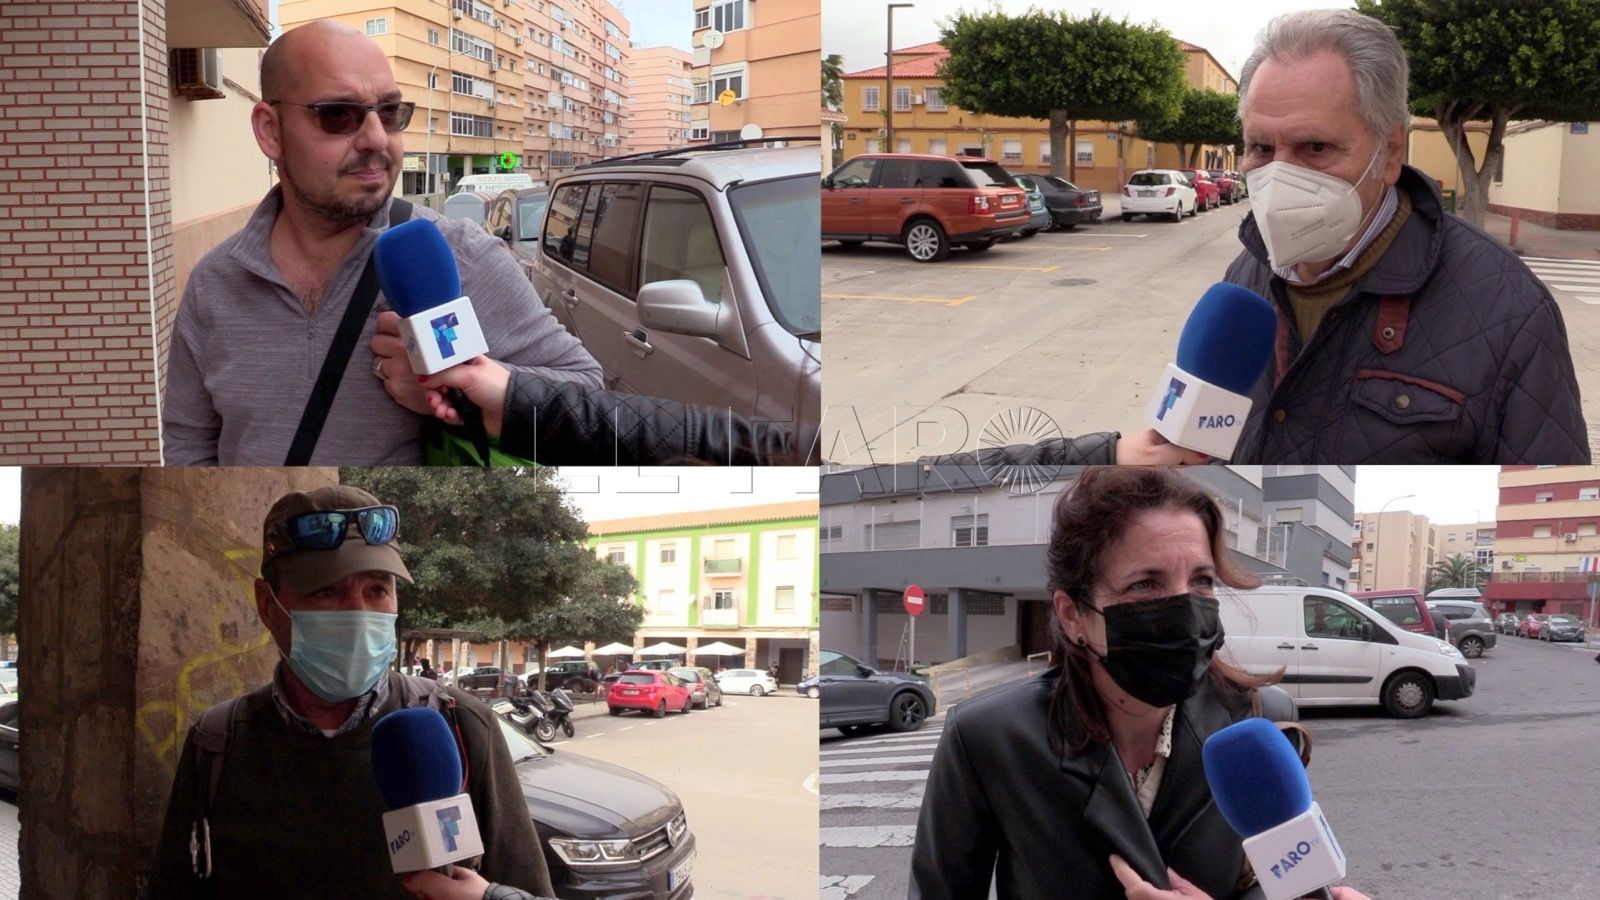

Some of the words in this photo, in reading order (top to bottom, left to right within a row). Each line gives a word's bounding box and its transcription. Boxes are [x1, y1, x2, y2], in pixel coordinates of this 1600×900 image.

[1198, 414, 1235, 429] FARO
[390, 830, 410, 855] FARO
[1270, 841, 1311, 880] FARO
